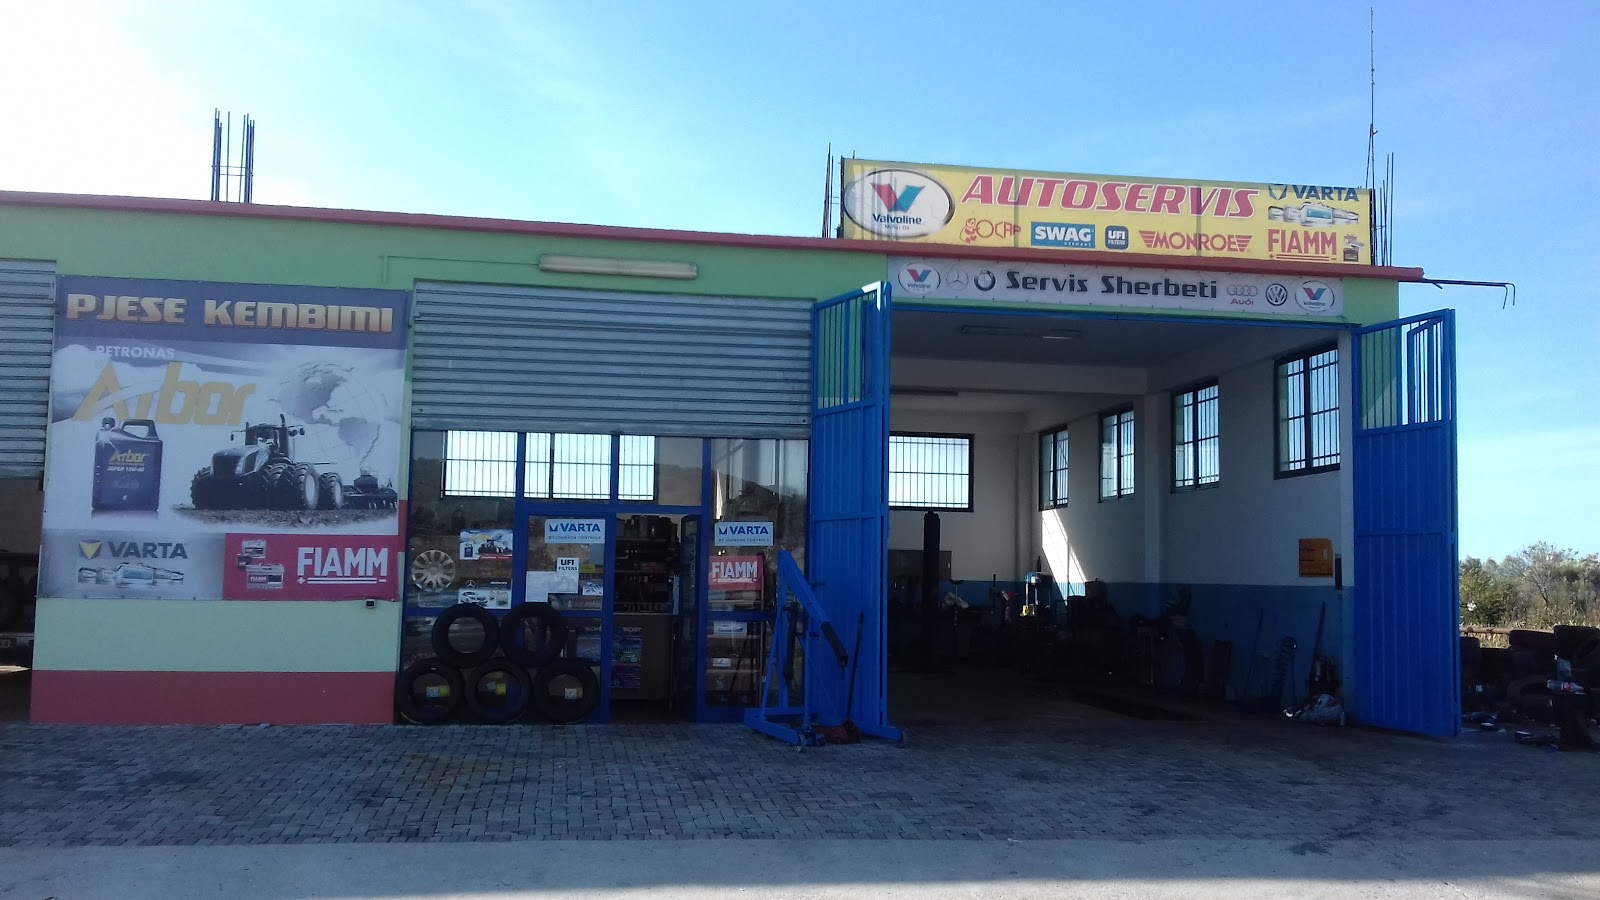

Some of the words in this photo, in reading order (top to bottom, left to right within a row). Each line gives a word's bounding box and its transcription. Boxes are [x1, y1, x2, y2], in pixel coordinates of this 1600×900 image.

[961, 174, 1260, 219] AUTOSERVIS
[1292, 184, 1360, 202] VARTA
[872, 213, 923, 225] Valvoline
[1034, 225, 1092, 242] SWAG
[1107, 230, 1126, 240] UFI
[1152, 230, 1238, 252] MONROE
[1267, 228, 1337, 256] FIAMM
[1006, 270, 1089, 293] Servis
[1101, 275, 1217, 299] Sherbeti
[1230, 298, 1254, 306] Audi
[66, 293, 187, 324] PJESE
[203, 299, 393, 333] KEMBIMI
[96, 345, 175, 360] PETRONAS
[71, 361, 257, 426] Arbor
[560, 522, 601, 532] VARTA
[729, 525, 769, 535] VARTA
[108, 541, 187, 559] VARTA
[297, 547, 388, 577] FIAMM
[711, 561, 758, 578] FIAMM
